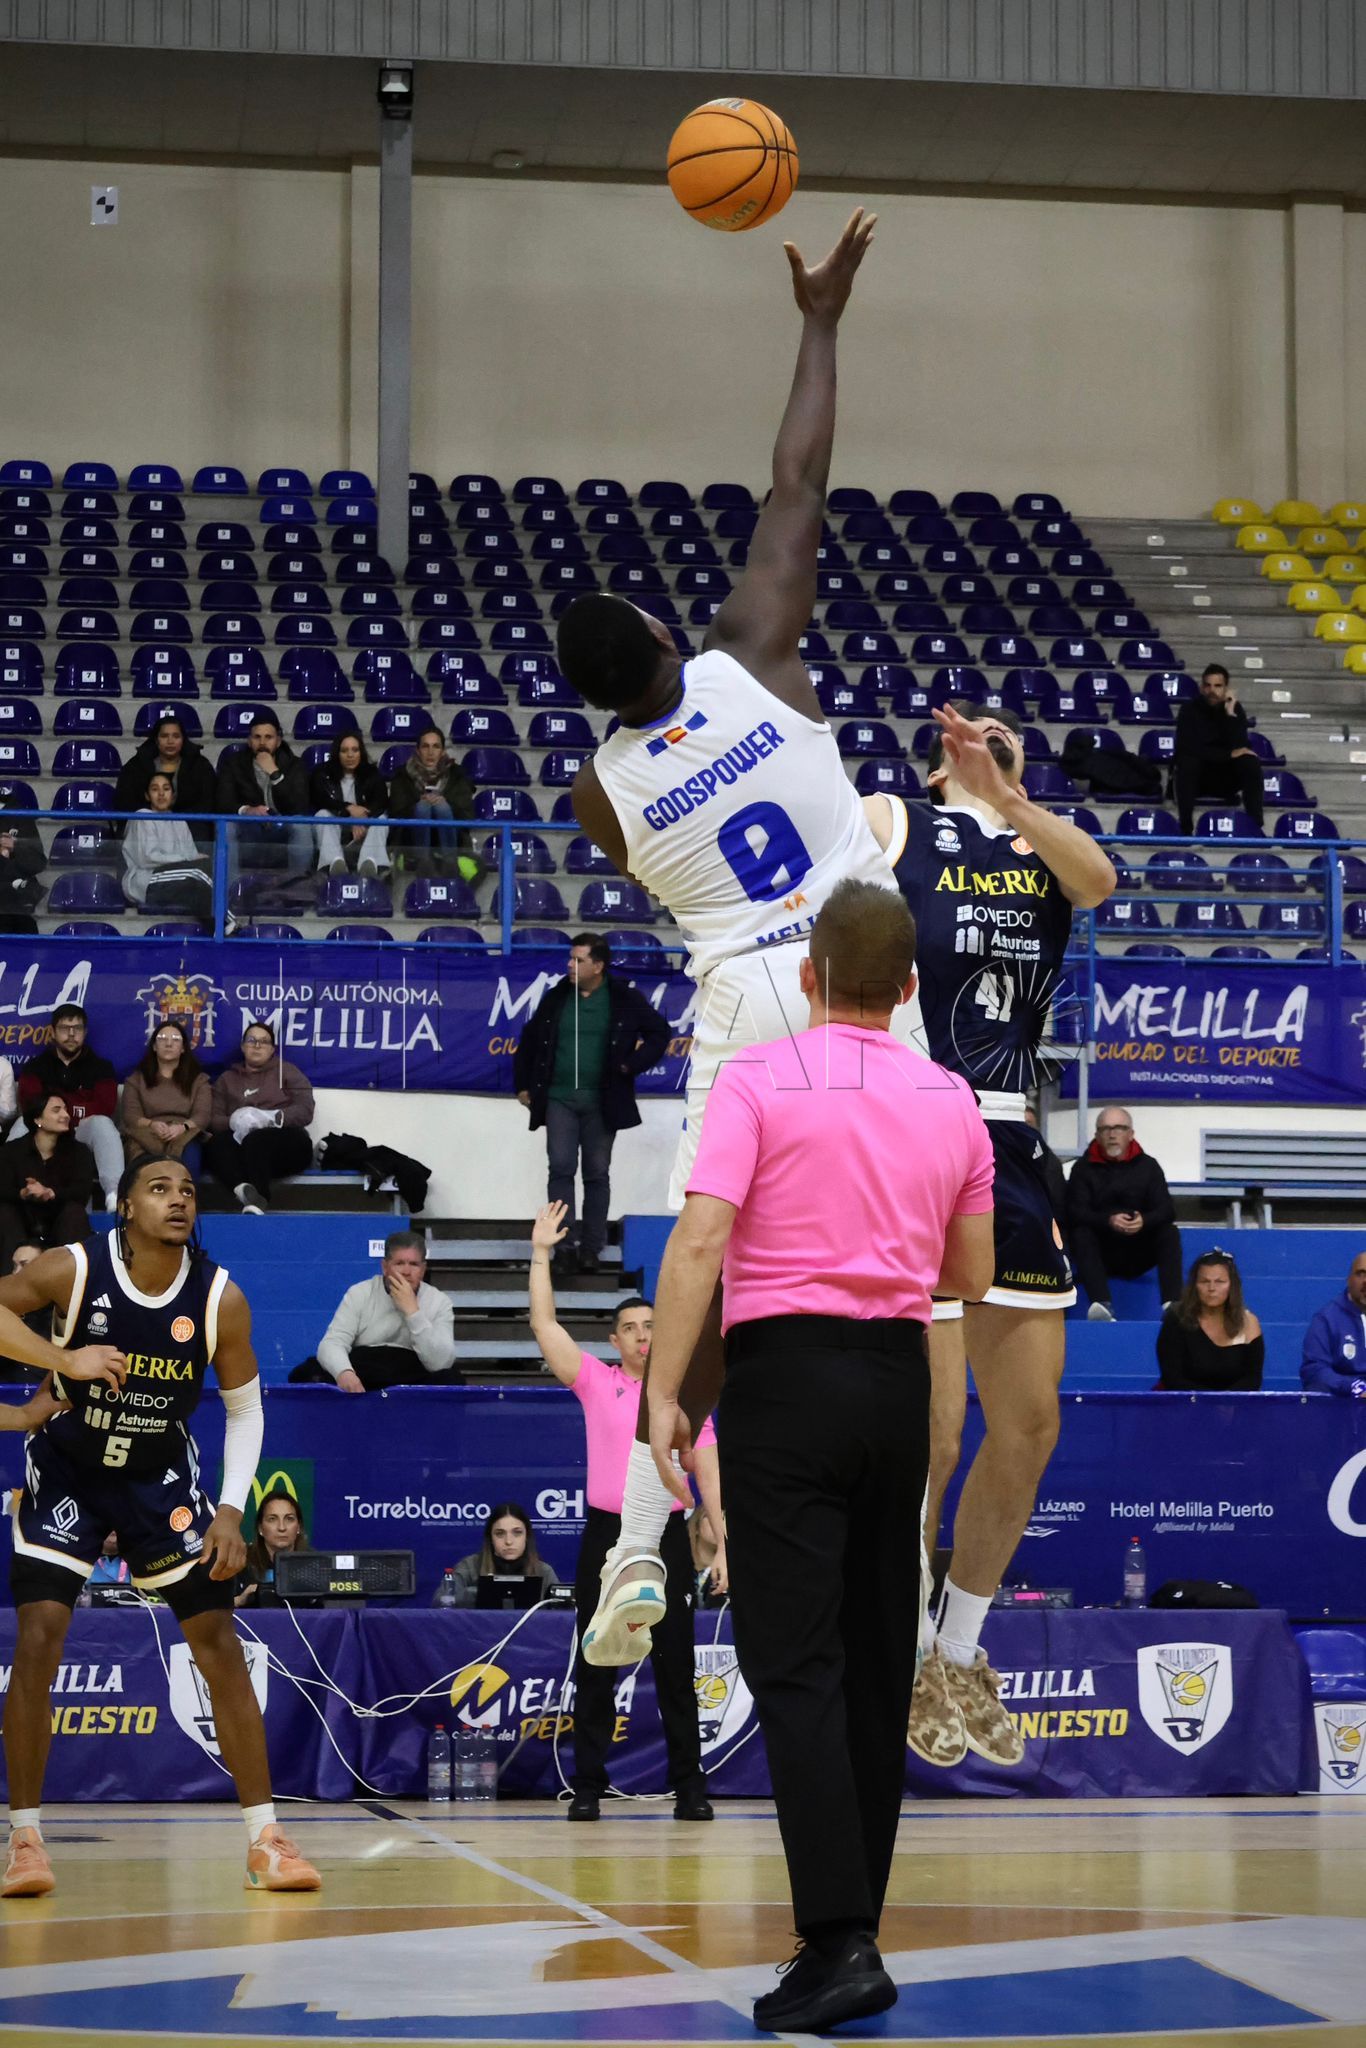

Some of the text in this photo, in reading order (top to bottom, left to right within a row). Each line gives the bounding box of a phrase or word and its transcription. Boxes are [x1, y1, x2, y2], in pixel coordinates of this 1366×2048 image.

[643, 721, 785, 831] GODSPOWER
[236, 981, 443, 1007] CIUDAD AUTÓNOMA
[255, 1006, 268, 1017] DE
[1094, 982, 1309, 1043] MELILLA
[240, 1007, 443, 1052] MELILLA
[1096, 1041, 1302, 1067] CIUDAD DEL DEPORTE
[1002, 1271, 1058, 1286] ALIMERKA
[105, 1389, 168, 1409] OVIEDO
[117, 1412, 168, 1428] Asturias
[102, 1435, 132, 1467] 5
[535, 1489, 584, 1519] GH
[1040, 1499, 1086, 1512] LÁZARO
[1110, 1502, 1274, 1517] Hotel Melilla Puerto
[997, 1669, 1096, 1700] ELILLA
[497, 1729, 516, 1741] del
